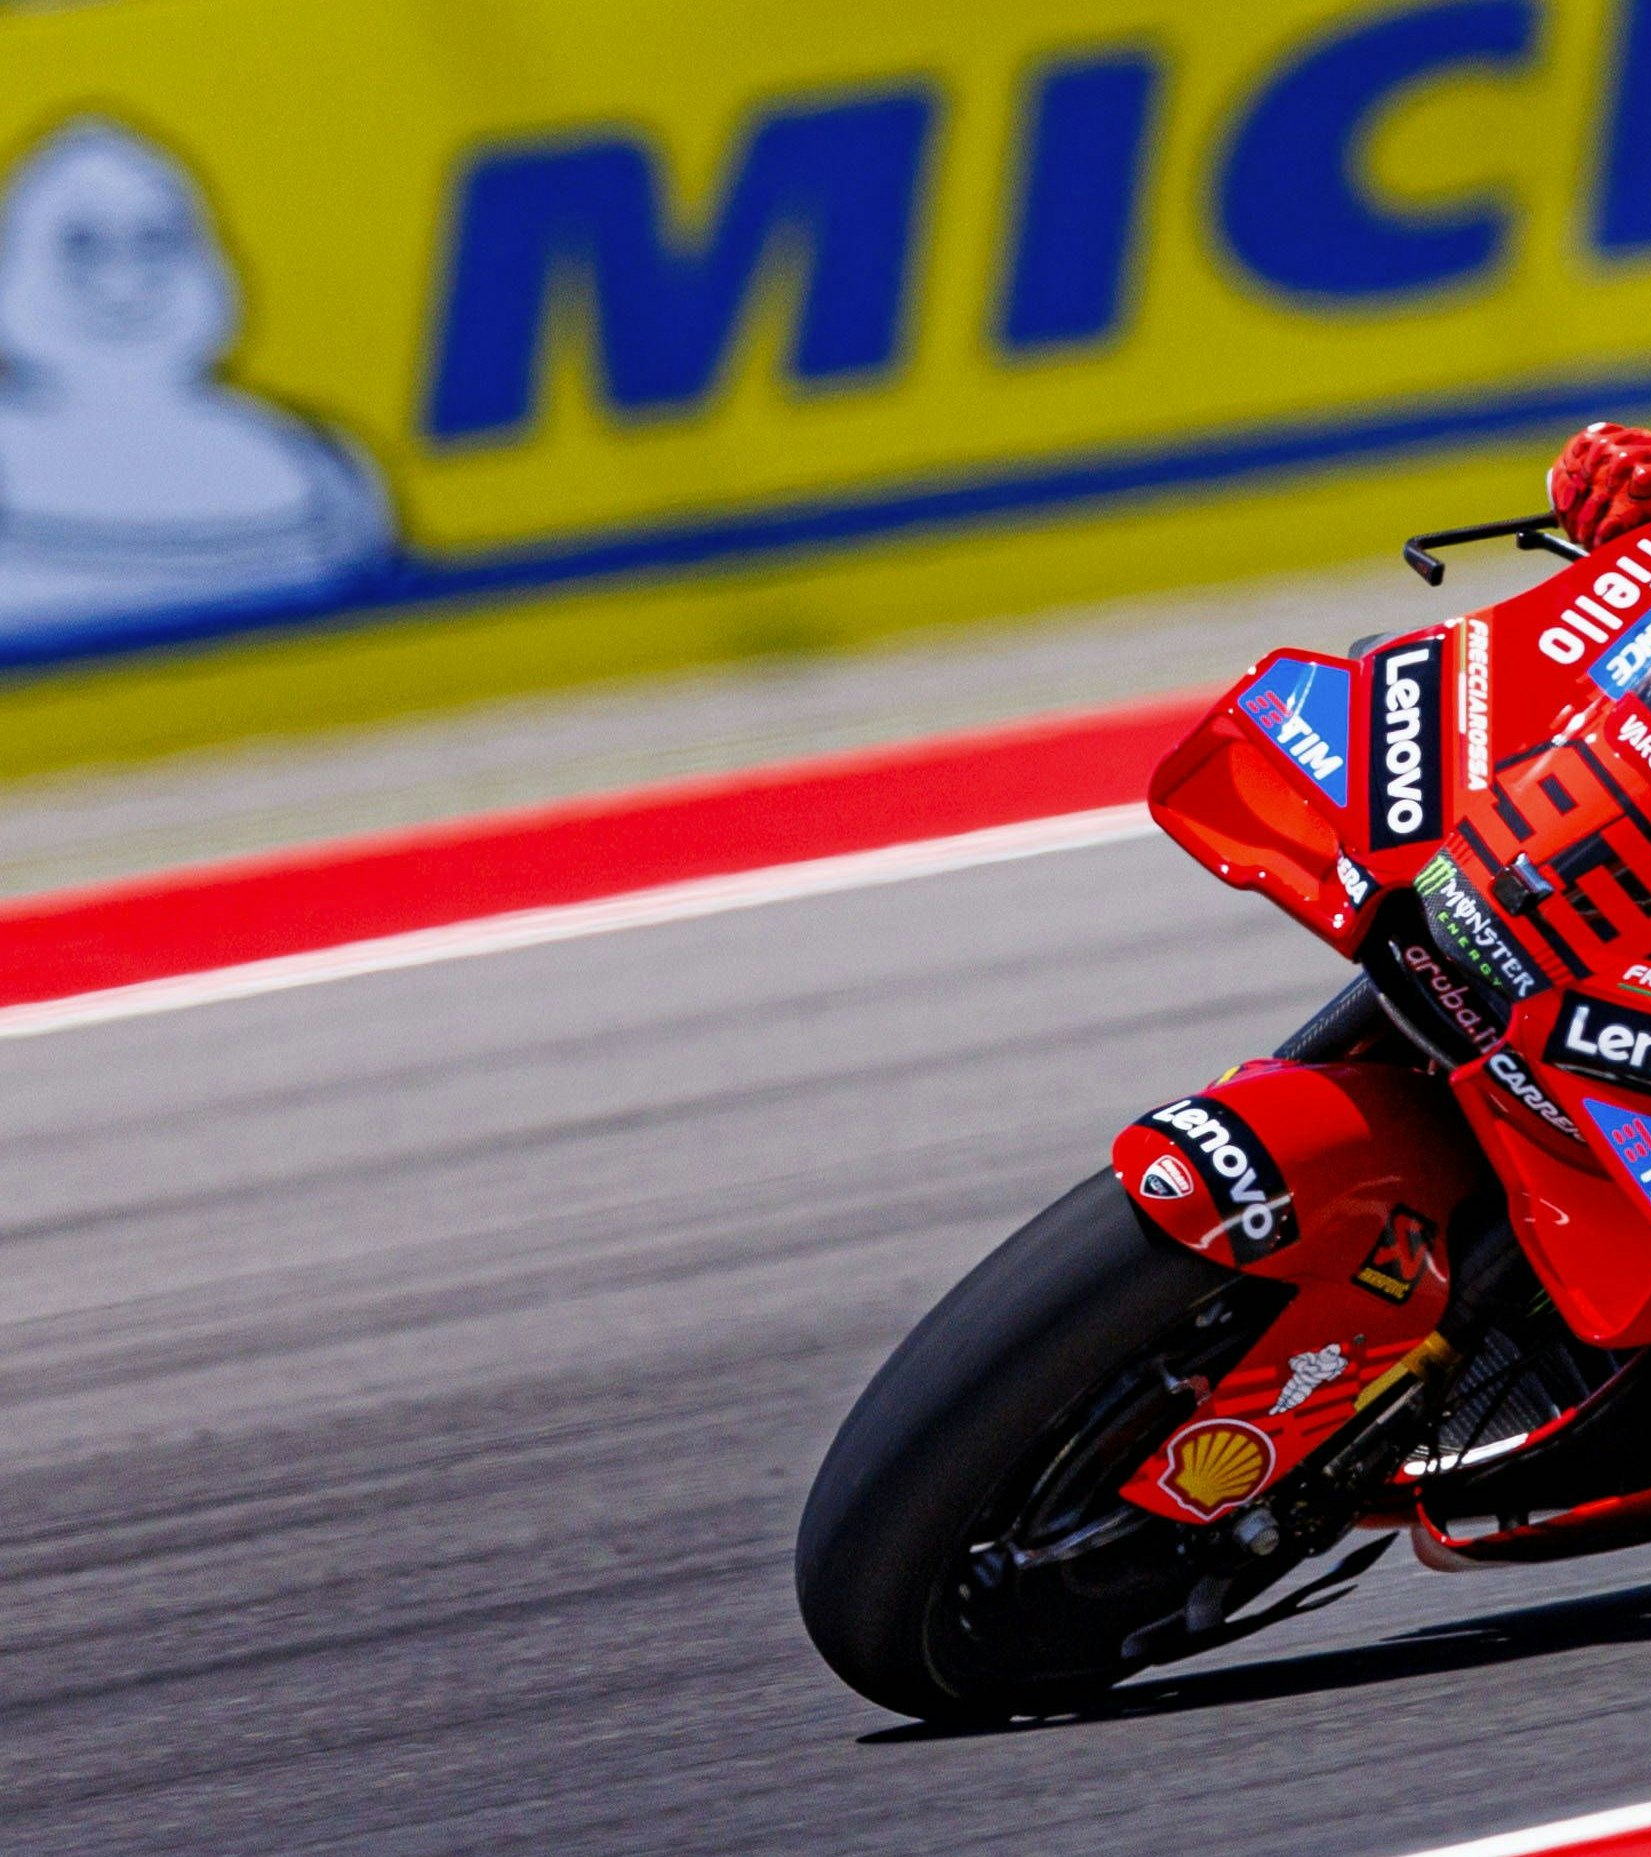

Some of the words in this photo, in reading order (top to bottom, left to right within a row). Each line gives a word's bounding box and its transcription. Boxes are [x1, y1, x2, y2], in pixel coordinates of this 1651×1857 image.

[1276, 712, 1343, 781] TIM
[1386, 648, 1430, 834] Lenovo
[1467, 618, 1490, 791] FRECCIAROSSA
[1152, 1099, 1274, 1240] Lenovo
